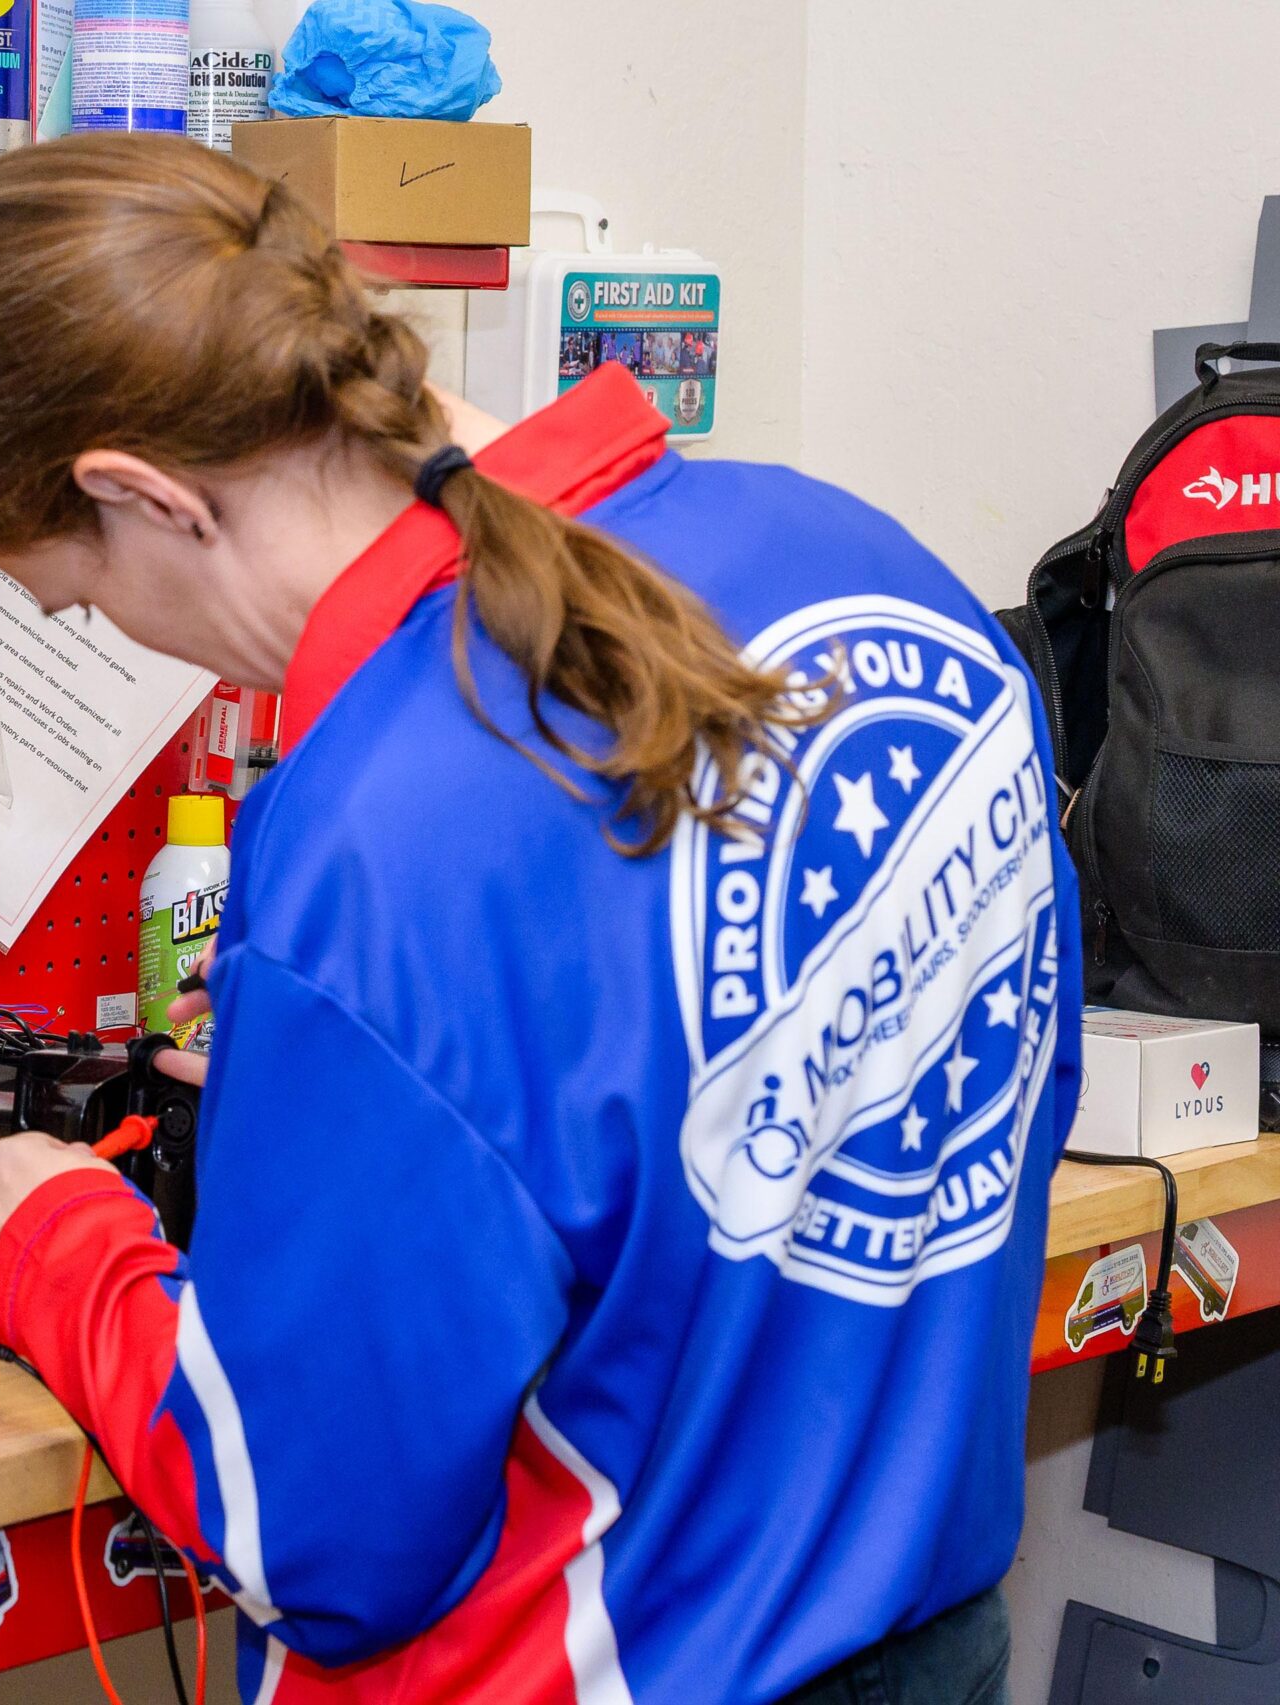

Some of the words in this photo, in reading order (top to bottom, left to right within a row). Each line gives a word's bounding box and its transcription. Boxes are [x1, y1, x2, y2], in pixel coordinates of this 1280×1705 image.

[228, 72, 266, 88] Solution
[594, 281, 640, 306] FIRST
[644, 282, 674, 306] AID
[680, 283, 706, 306] KIT
[6, 579, 21, 593] any
[49, 612, 65, 627] card
[62, 624, 77, 637] any
[74, 632, 99, 654] pallets
[96, 649, 111, 663] and
[108, 660, 139, 685] garbage.
[18, 621, 46, 645] vehicles
[43, 642, 57, 654] are
[54, 650, 80, 672] locked.
[2, 642, 19, 657] area
[16, 653, 47, 678] cleaned,
[44, 674, 62, 690] clear
[60, 686, 75, 700] and
[72, 697, 106, 725] organized
[104, 720, 113, 730] at
[111, 726, 122, 737] all
[2, 675, 27, 696] repairs
[24, 692, 39, 705] and
[37, 701, 57, 719] Work
[54, 715, 80, 736] Orders.
[935, 656, 972, 709] A
[4, 693, 23, 710] open
[21, 706, 49, 729] statuses
[47, 726, 56, 735] or
[54, 731, 71, 747] jobs
[68, 742, 94, 765] waiting
[92, 761, 103, 771] on
[218, 705, 228, 753] GENERAL
[20, 737, 36, 754] parts
[37, 750, 44, 759] or
[44, 754, 74, 782] resources
[74, 779, 89, 793] that
[1175, 1095, 1224, 1119] LYDUS
